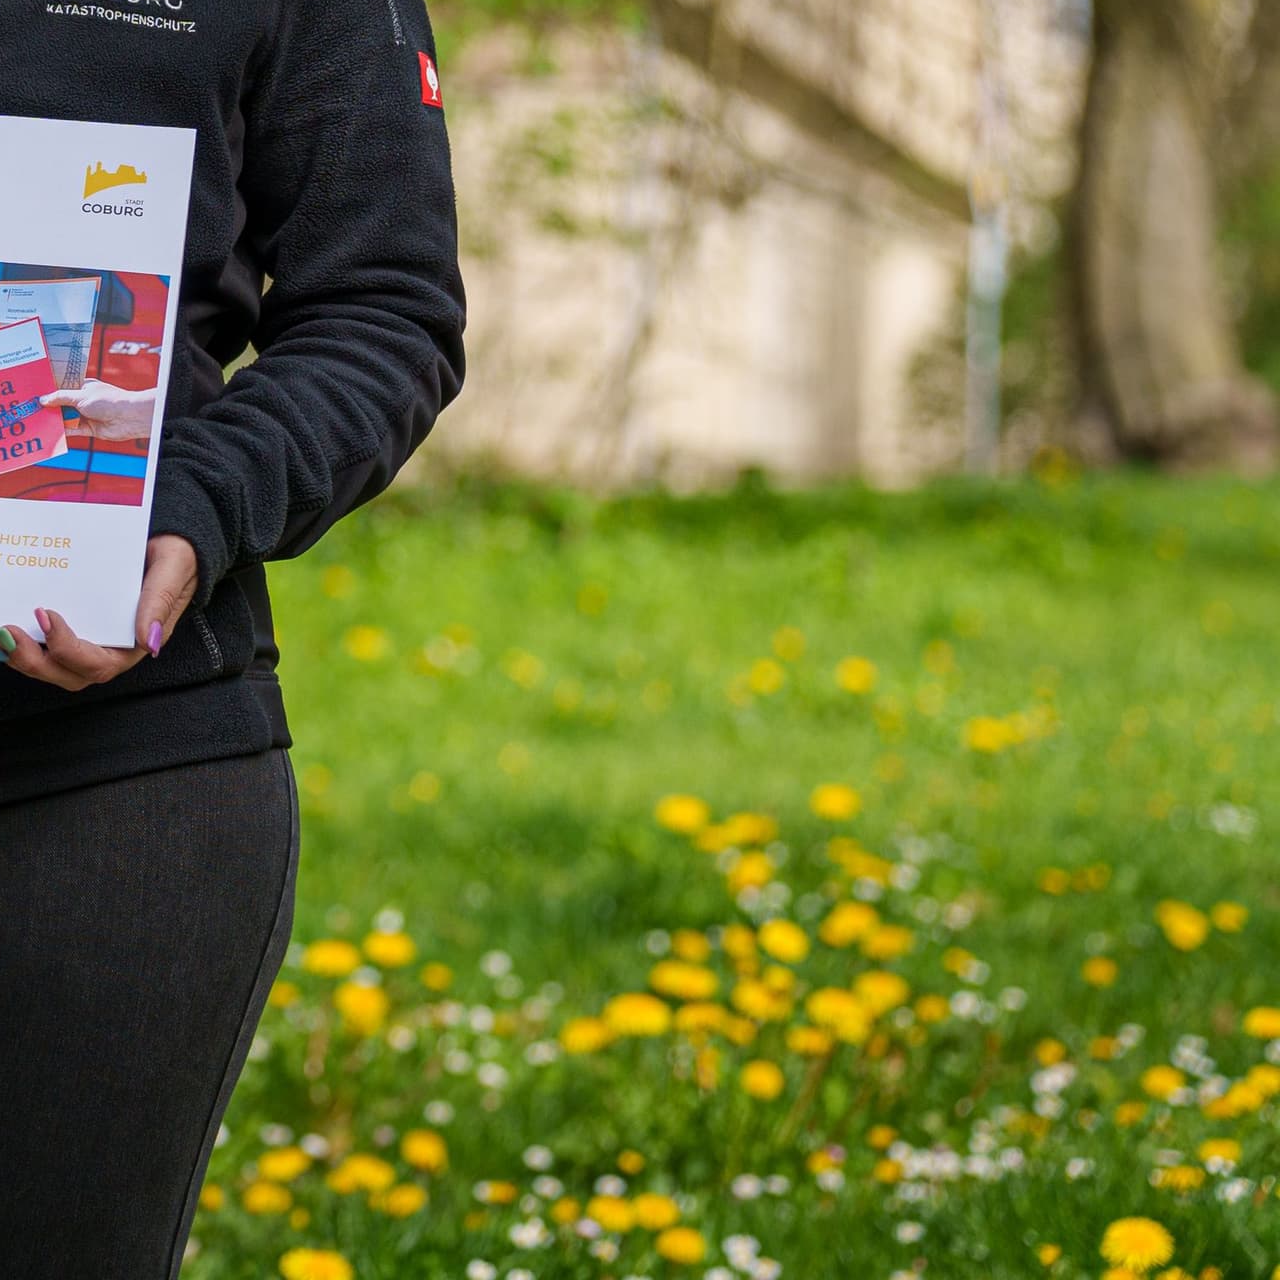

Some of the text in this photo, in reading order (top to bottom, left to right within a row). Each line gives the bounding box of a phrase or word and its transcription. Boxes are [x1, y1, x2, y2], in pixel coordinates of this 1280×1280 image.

[46, 3, 196, 33] KATASTROPHENSCHUTZ
[81, 203, 144, 218] COBURG
[42, 535, 72, 550] DER
[6, 553, 70, 569] COBURG
